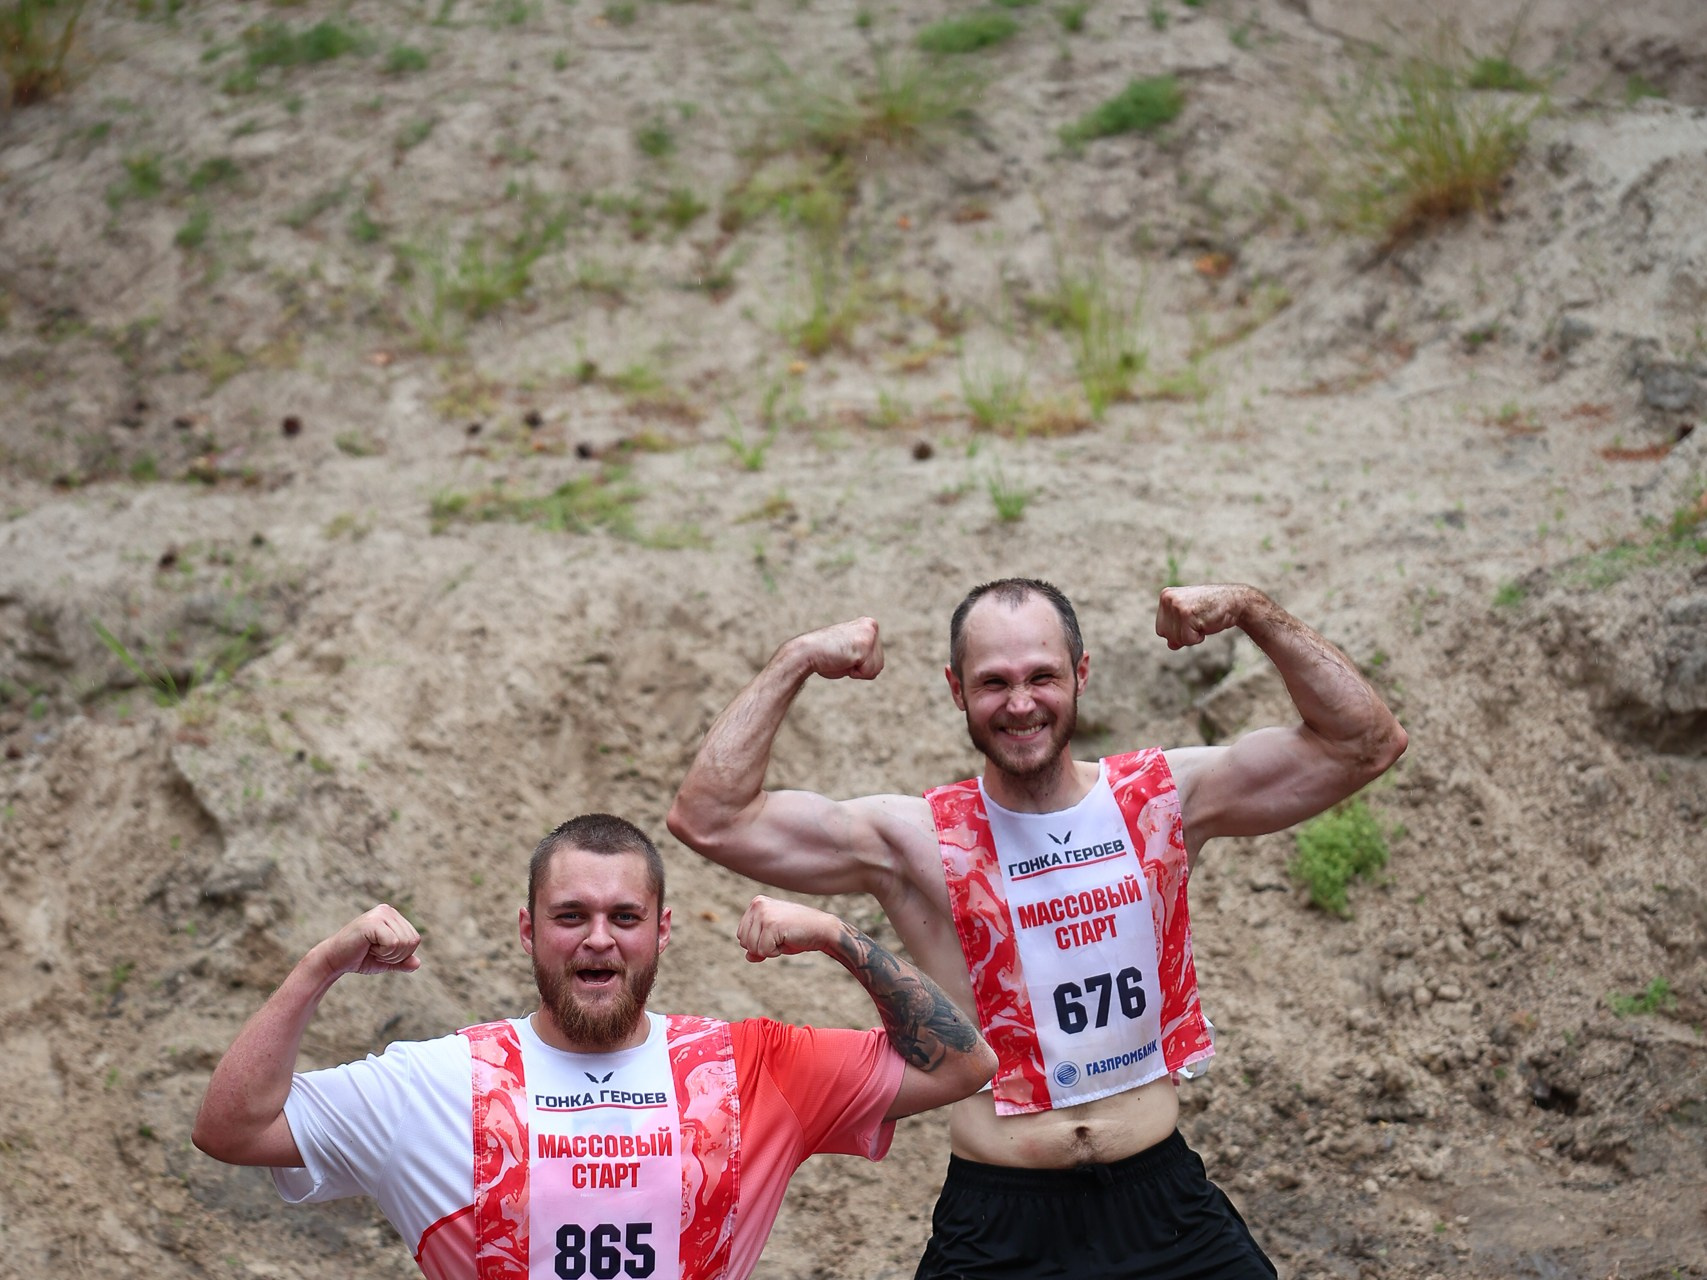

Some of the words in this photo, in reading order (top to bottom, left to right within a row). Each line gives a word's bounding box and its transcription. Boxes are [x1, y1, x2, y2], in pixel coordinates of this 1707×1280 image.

[1008, 852, 1062, 877] ГОНКА
[1065, 839, 1125, 863] ГЕРОЕВ
[1017, 874, 1143, 930] МАССОВЫЙ
[1054, 913, 1118, 951] СТАРТ
[1052, 965, 1147, 1035] 676
[1086, 1038, 1158, 1077] ГАЗПРОМБАНК
[535, 1091, 595, 1108] ГОНКА
[600, 1089, 667, 1104] ГЕРОЕВ
[537, 1126, 673, 1159] МАССОВЫЙ
[571, 1162, 641, 1189] СТАРТ
[554, 1222, 656, 1280] 865
